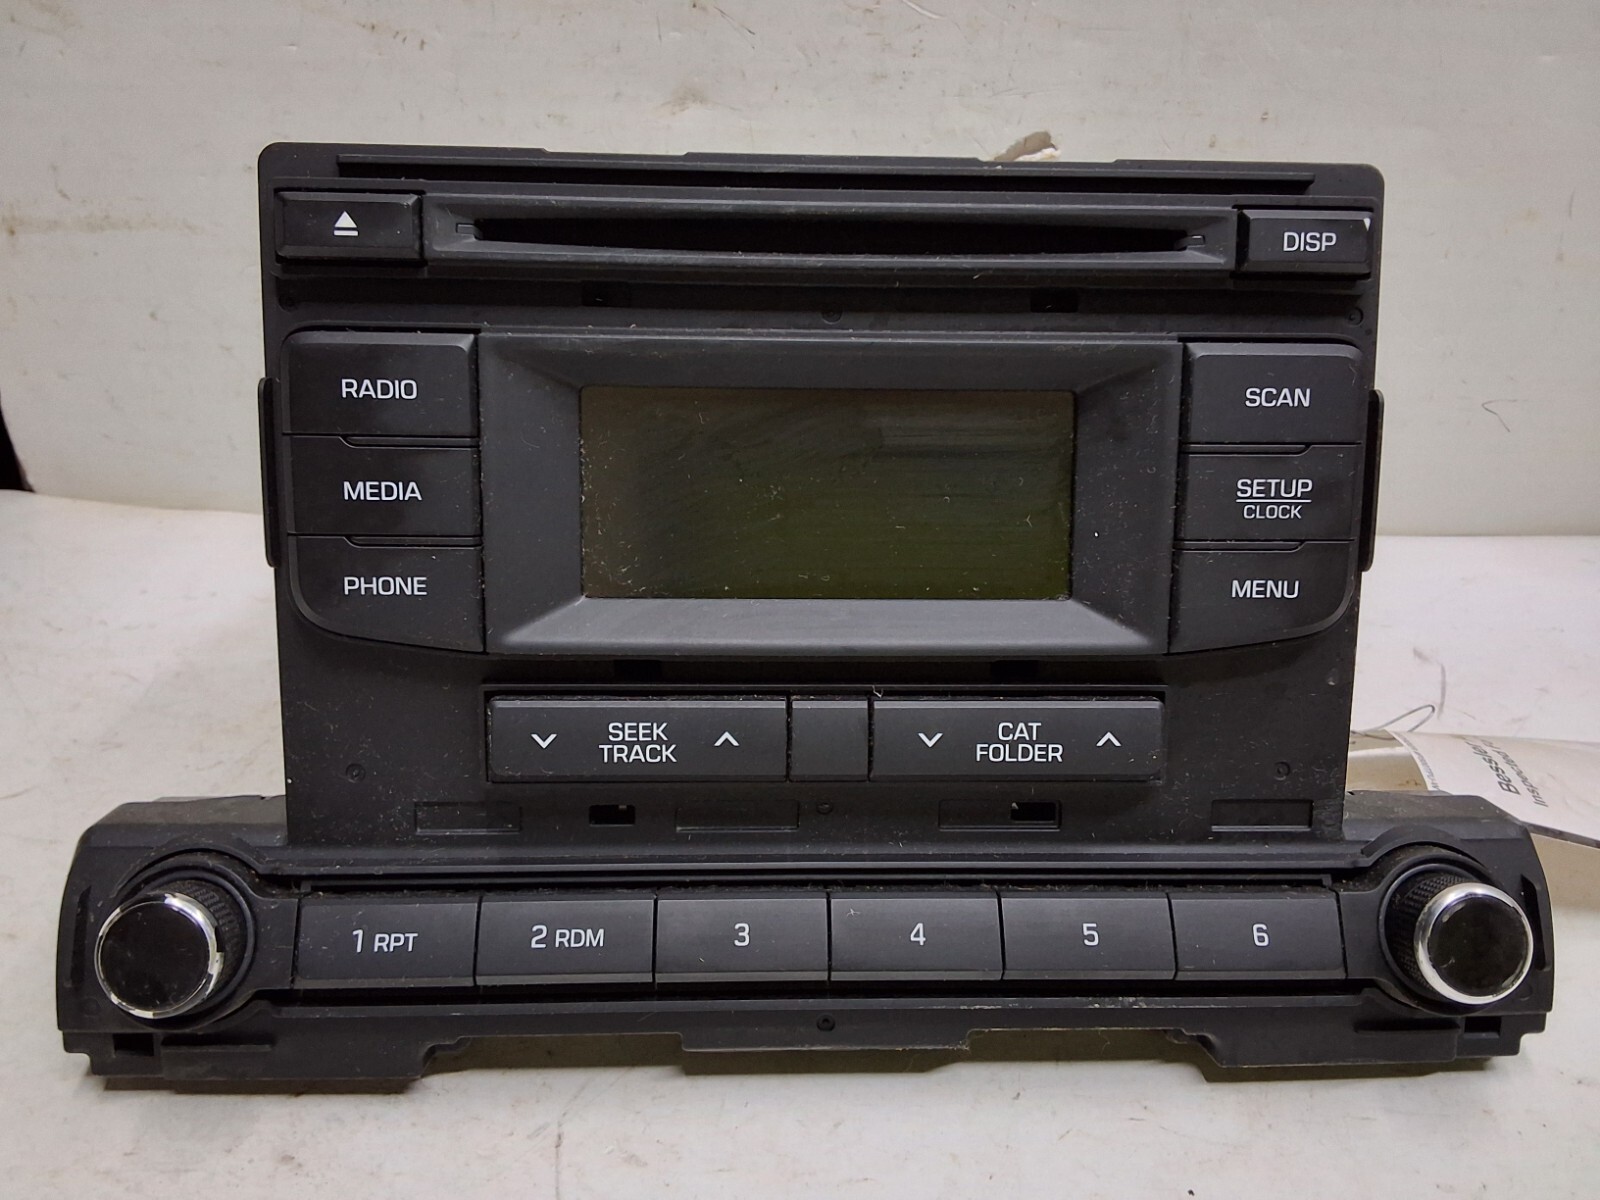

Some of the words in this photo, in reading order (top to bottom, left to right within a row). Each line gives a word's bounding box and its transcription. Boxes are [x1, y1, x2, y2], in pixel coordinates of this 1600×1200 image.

[1283, 231, 1337, 252] DISP
[341, 378, 418, 400] RADIO
[1245, 387, 1311, 407] SCAN
[343, 481, 423, 501] MEDIA
[1236, 478, 1313, 498] SETUP
[1243, 504, 1302, 519] CLOCK
[344, 576, 428, 596] PHONE
[1231, 579, 1299, 599] MENU
[608, 722, 668, 742] SEEK
[998, 722, 1042, 741] CAT
[598, 744, 677, 763] TRACK
[976, 743, 1063, 762] FOLDER
[352, 929, 364, 953] 1
[373, 932, 419, 953] RPT
[530, 924, 548, 949] 2
[555, 928, 605, 948] RDM
[734, 922, 750, 947] 3
[910, 922, 926, 946] 4
[1082, 922, 1099, 946] 5
[1252, 923, 1269, 947] 6
